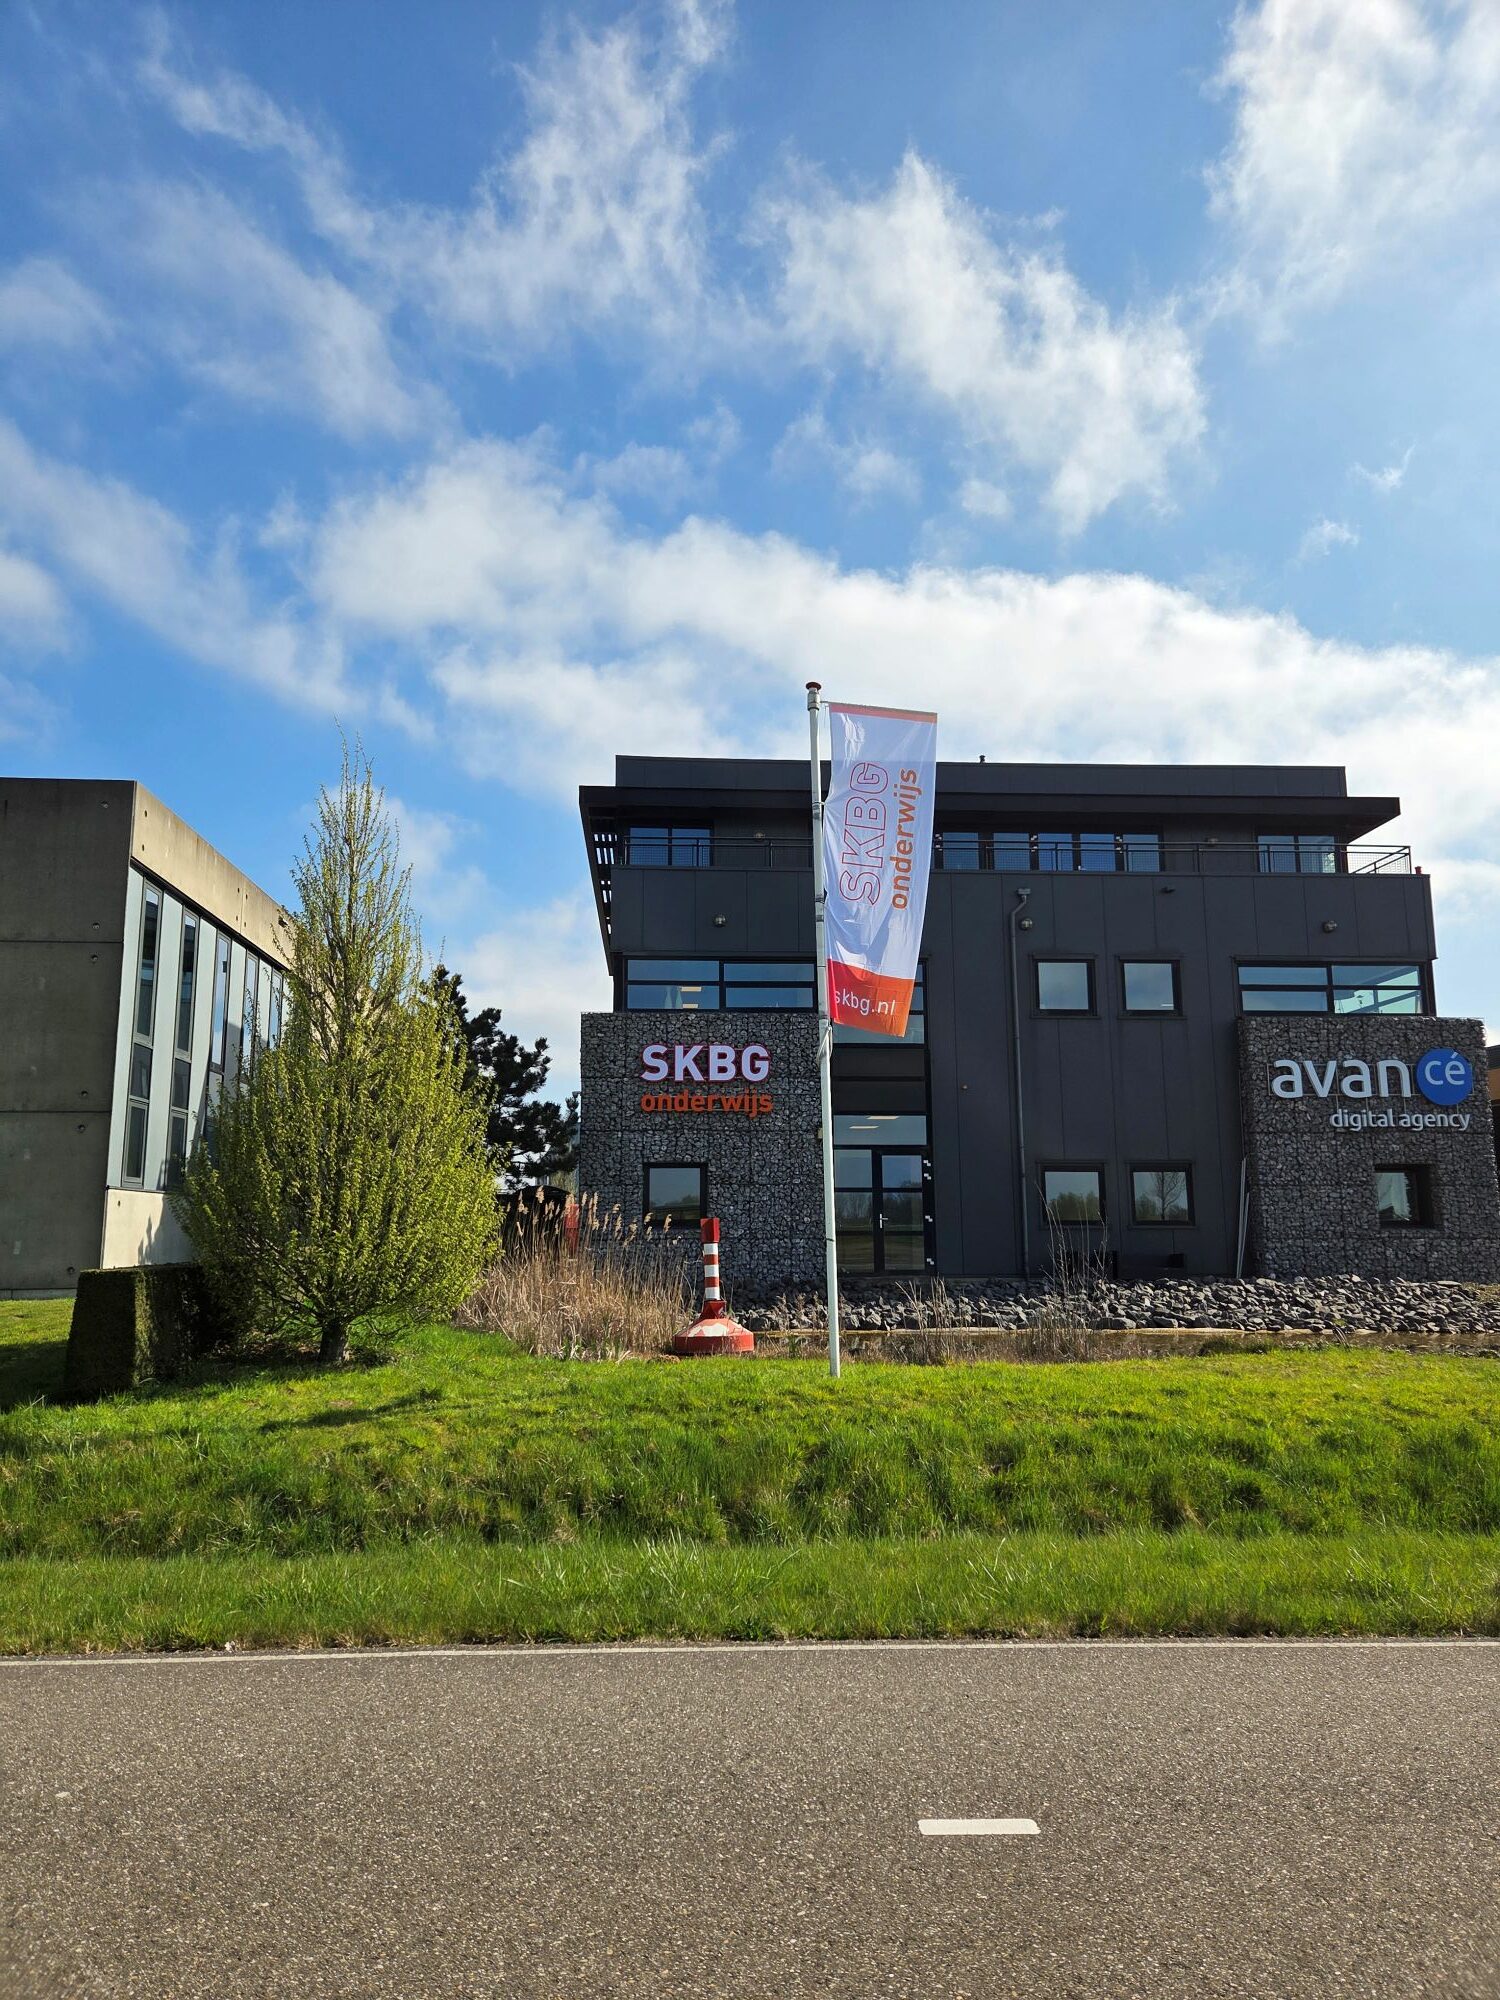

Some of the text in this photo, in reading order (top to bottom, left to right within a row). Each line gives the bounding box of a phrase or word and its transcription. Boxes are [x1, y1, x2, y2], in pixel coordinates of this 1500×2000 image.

[840, 762, 890, 906] SKBG
[889, 767, 923, 911] onderwijs
[834, 989, 896, 1016] skbg.nl
[641, 1043, 771, 1083] SKBG
[640, 1089, 773, 1119] onderwijs
[1330, 1108, 1471, 1131] digital agency
